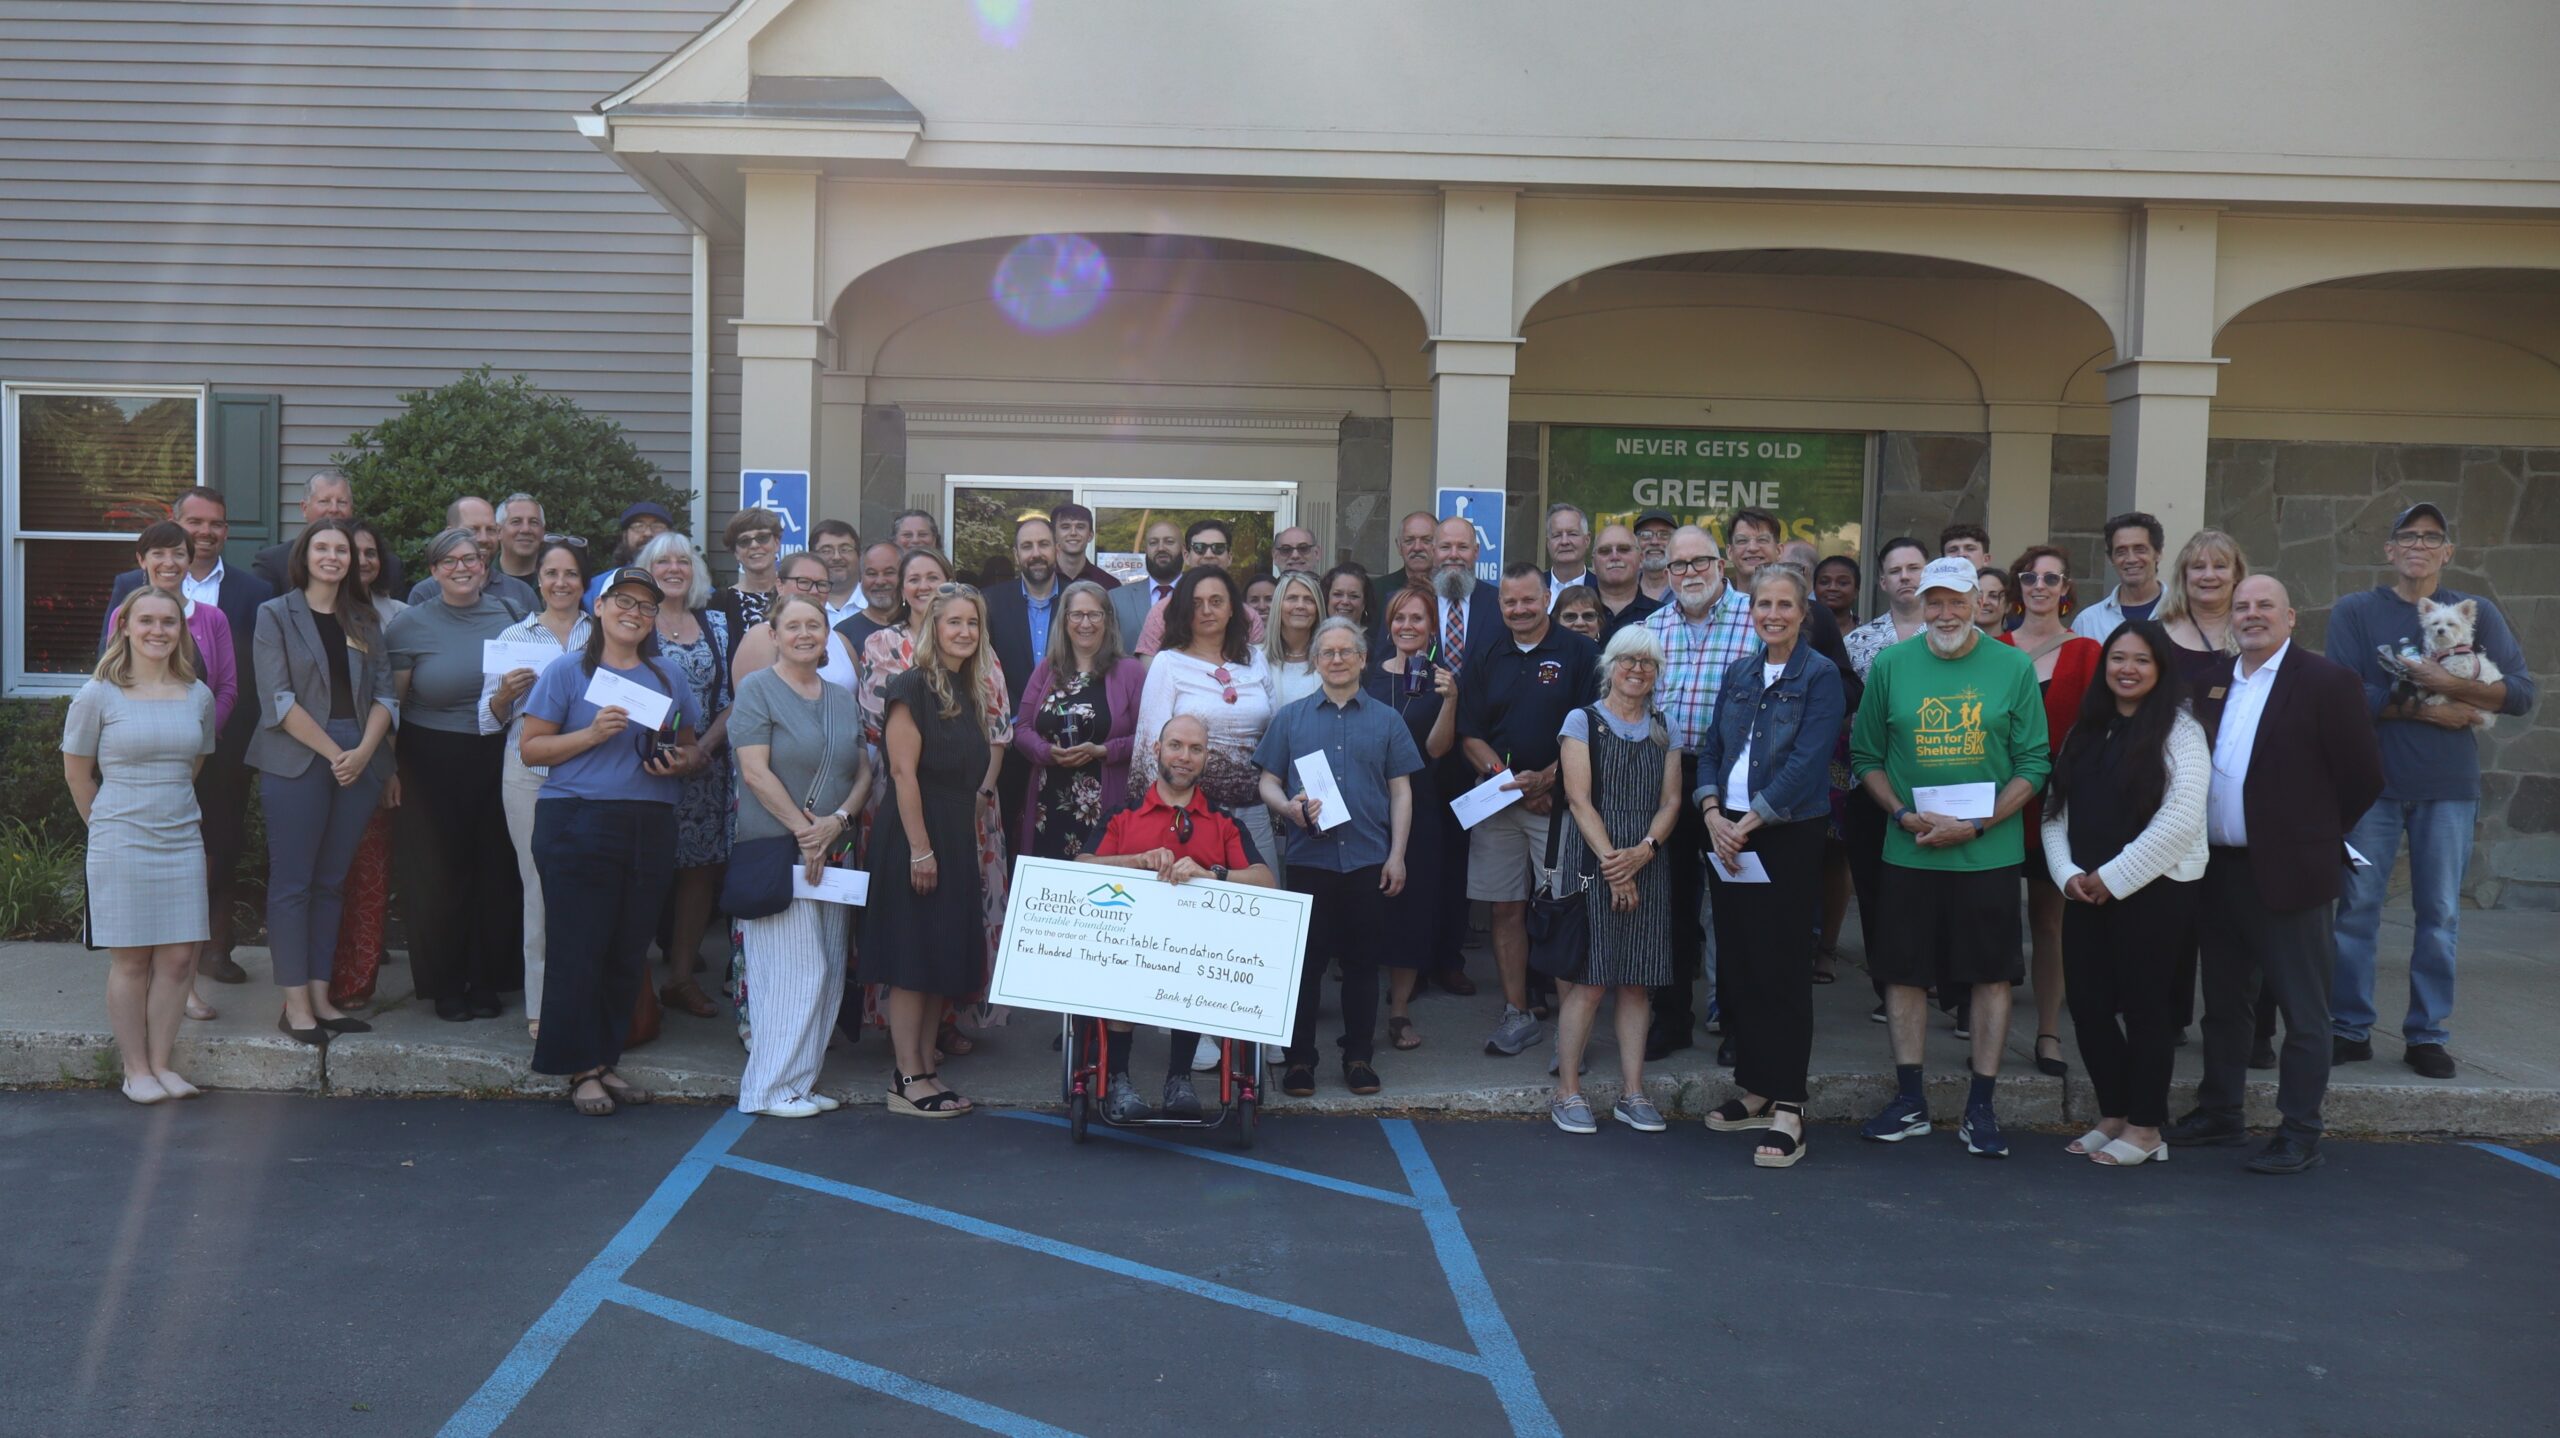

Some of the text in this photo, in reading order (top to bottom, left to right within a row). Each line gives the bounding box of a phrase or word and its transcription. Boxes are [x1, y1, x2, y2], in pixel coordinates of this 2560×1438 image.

[1615, 438, 1802, 459] NEVER GETS OLD
[1632, 478, 1780, 509] GREENE
[1916, 734, 1962, 744] Run for
[1963, 732, 1986, 754] 5K
[1916, 745, 1962, 756] Shelter
[1040, 887, 1077, 904] Bank
[1177, 899, 1197, 908] DATE
[1201, 890, 1260, 917] 2026
[1025, 896, 1133, 925] Greene County
[1020, 926, 1034, 936] Pay
[1035, 928, 1043, 936] to
[1044, 929, 1056, 937] the
[1057, 930, 1077, 940] order
[1023, 912, 1126, 933] Charitable Foundation
[1016, 939, 1034, 954] Five
[1038, 942, 1073, 958] Hundred
[1135, 953, 1181, 974] Thousand
[1096, 930, 1264, 968] Charitable Foundation Grants
[1155, 988, 1264, 1020] Bank of Greene County
